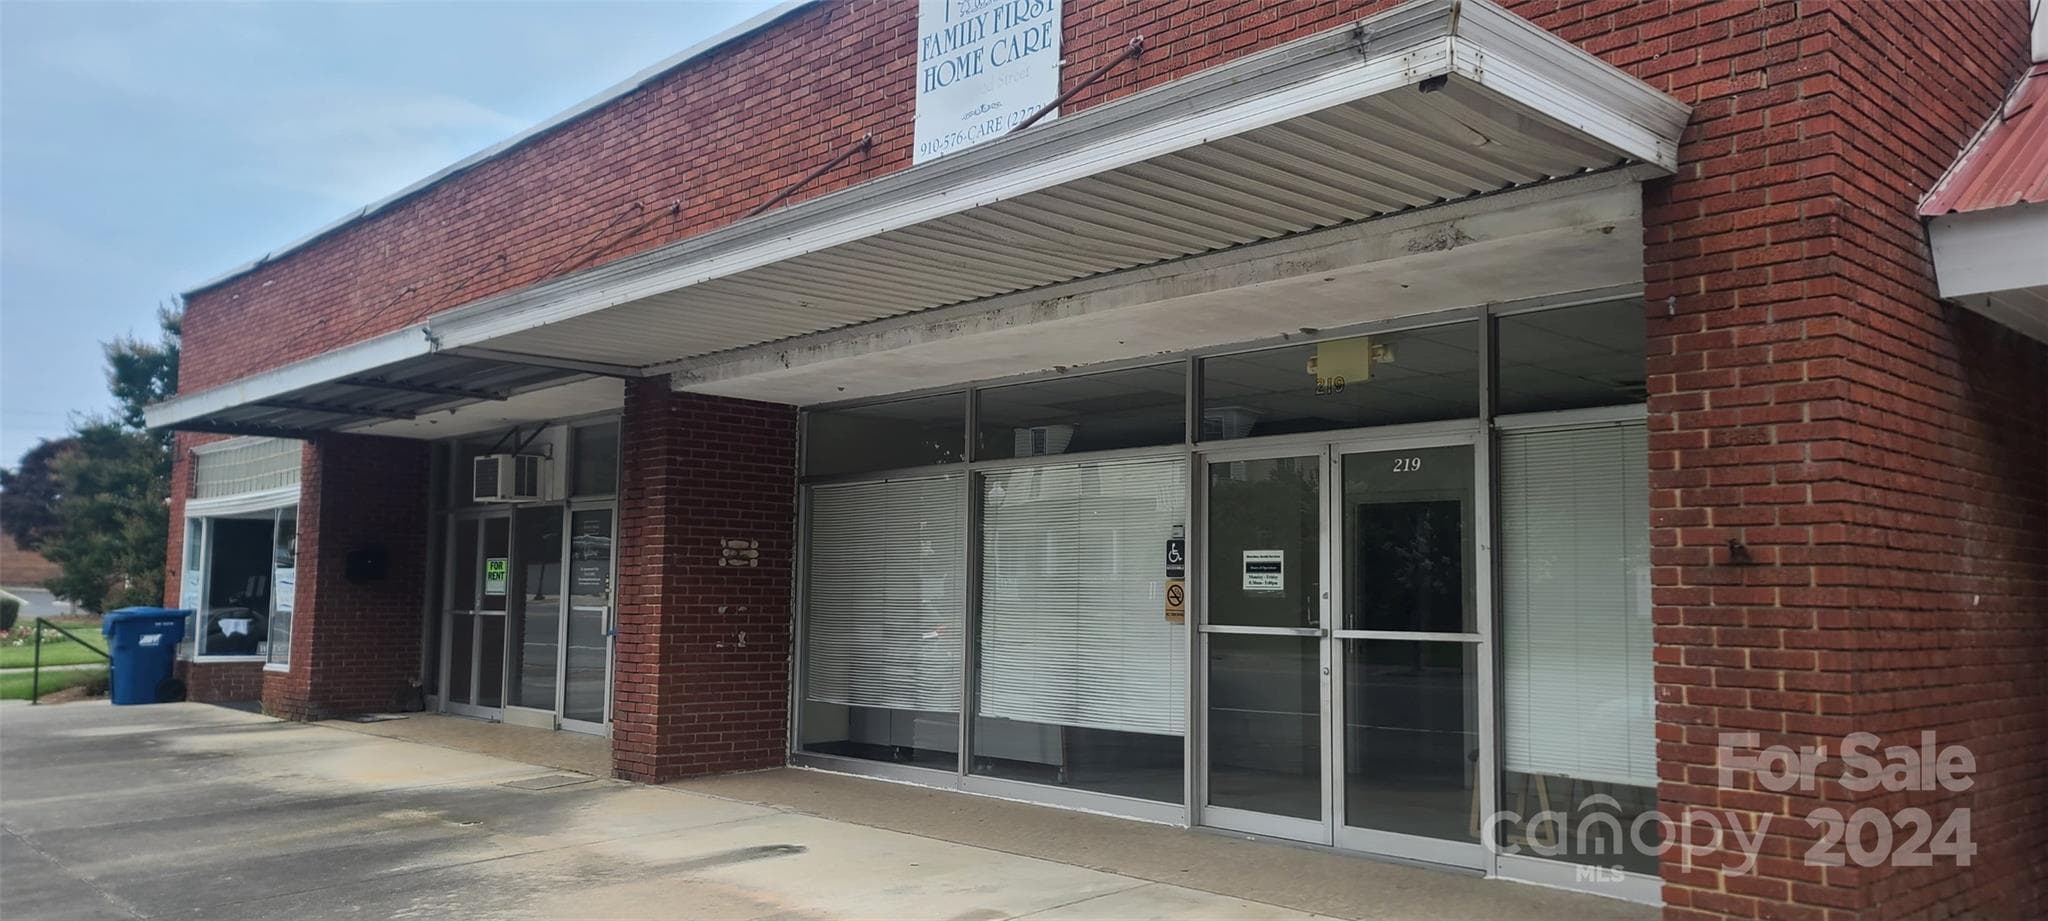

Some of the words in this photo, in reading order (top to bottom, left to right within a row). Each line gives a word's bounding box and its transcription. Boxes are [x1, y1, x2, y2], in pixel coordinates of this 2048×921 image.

[921, 12, 989, 62] FAMILY
[922, 47, 984, 94] HOME
[990, 18, 1053, 67] CARE
[920, 116, 1003, 157] 910-576-CARE
[1315, 376, 1345, 396] 219
[1393, 457, 1421, 472] 219
[488, 571, 504, 580] RENT
[490, 561, 504, 570] FOR
